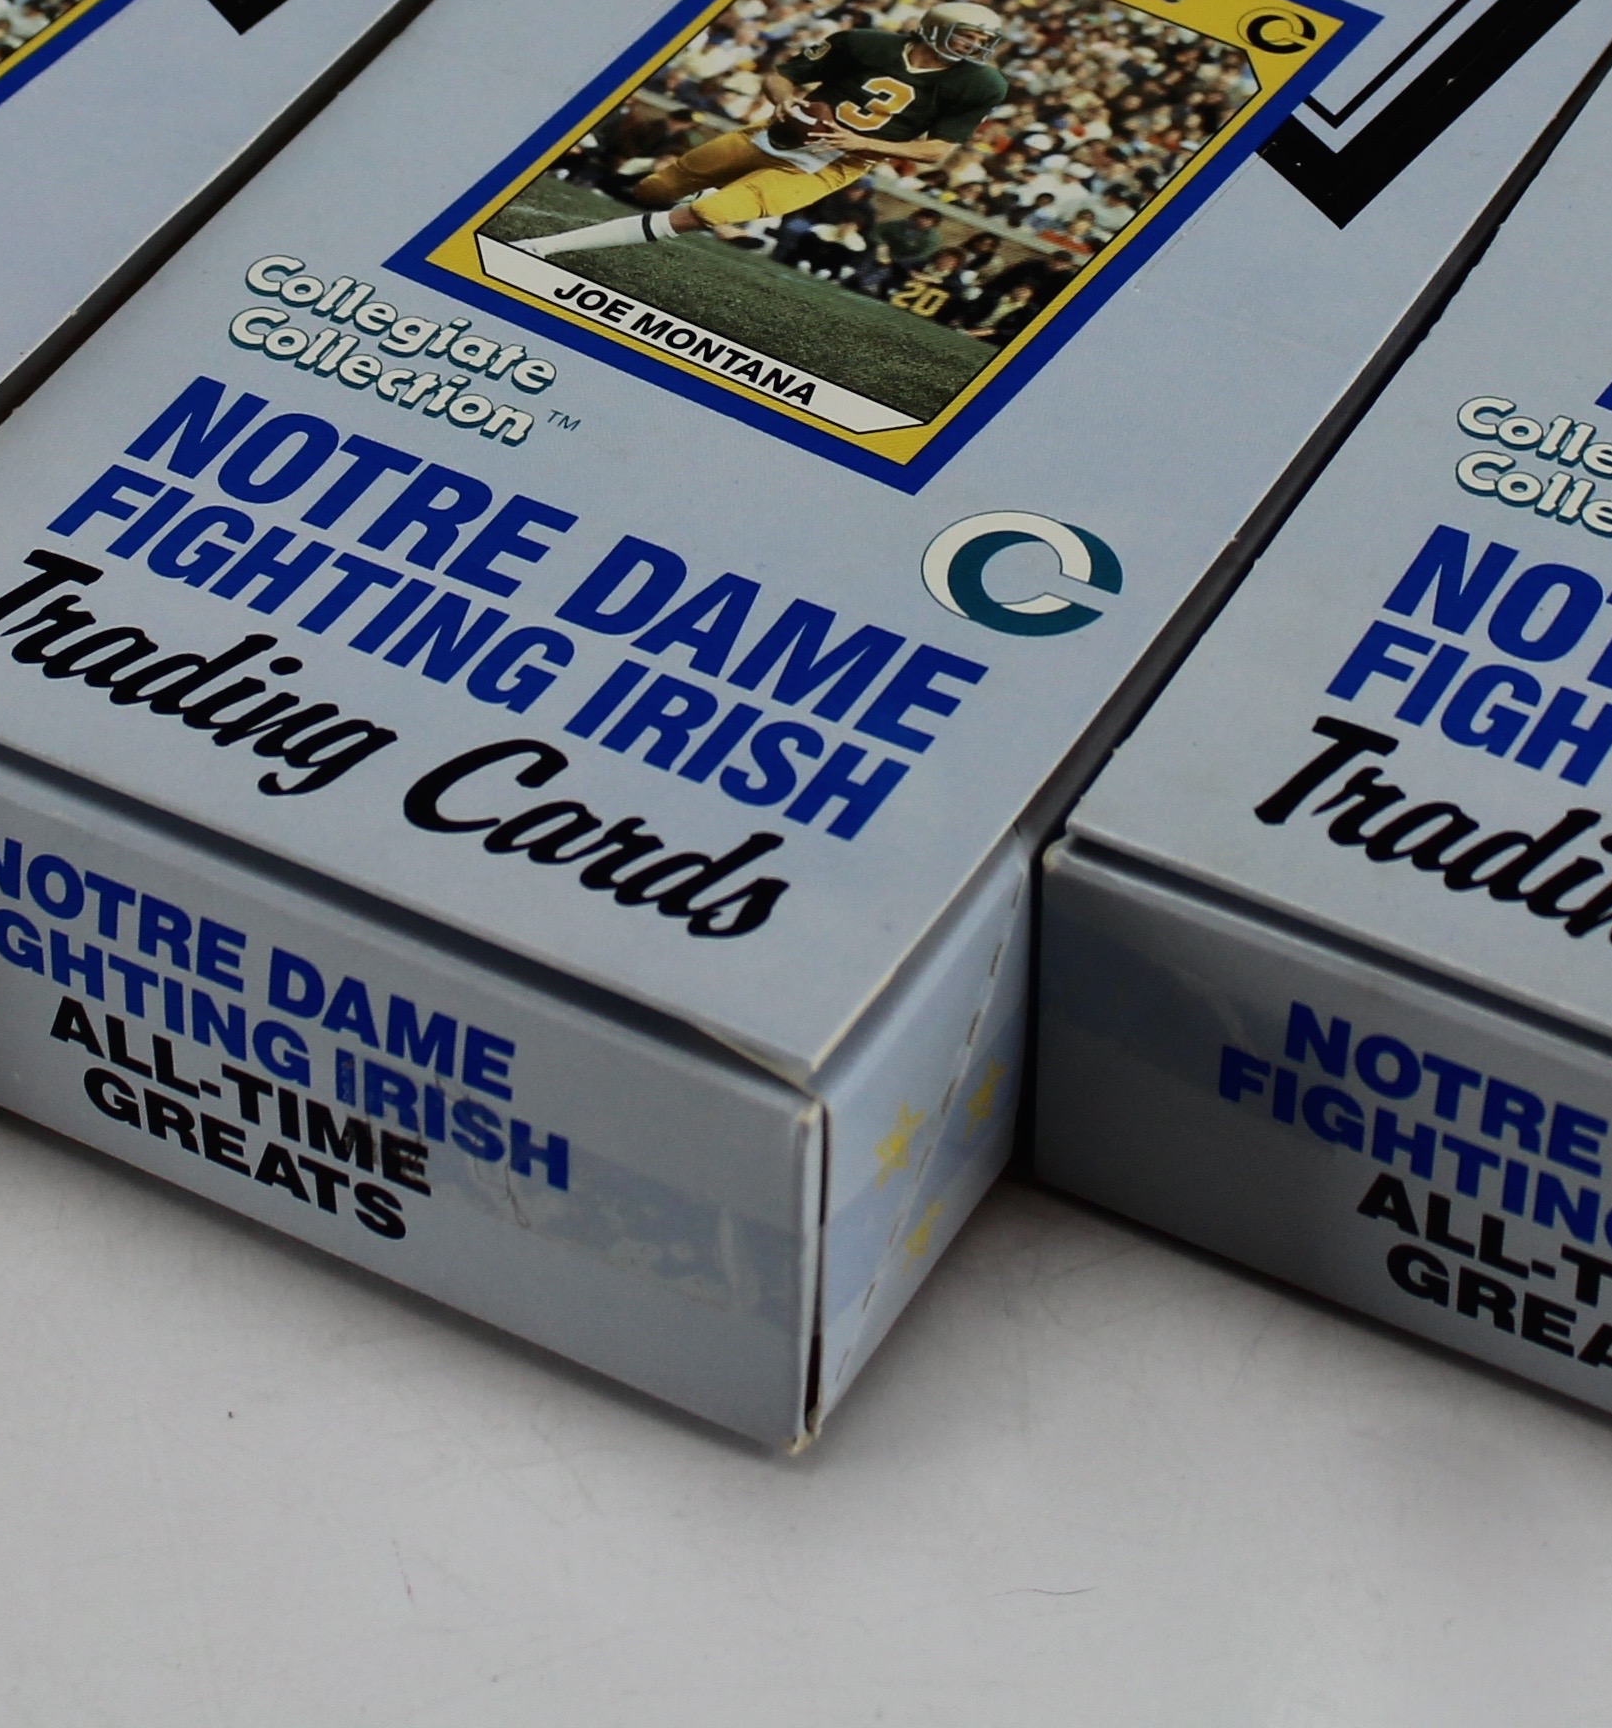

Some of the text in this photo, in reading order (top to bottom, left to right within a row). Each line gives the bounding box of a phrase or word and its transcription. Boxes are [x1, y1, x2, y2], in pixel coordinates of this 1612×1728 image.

[836, 77, 915, 131] 3
[228, 308, 534, 445] Collection
[246, 255, 557, 395] Collegiate
[553, 281, 817, 408] JOE MONTANA
[124, 374, 989, 751] NOTRE DAME
[46, 463, 910, 842] FIGHTING IRISH
[403, 738, 789, 940] Cards
[49, 995, 431, 1198] ALL-TIME
[269, 947, 516, 1102] DAME
[1284, 1001, 1608, 1179] NOTRE
[83, 1067, 407, 1240] GREATS
[335, 1050, 569, 1191] IRISH
